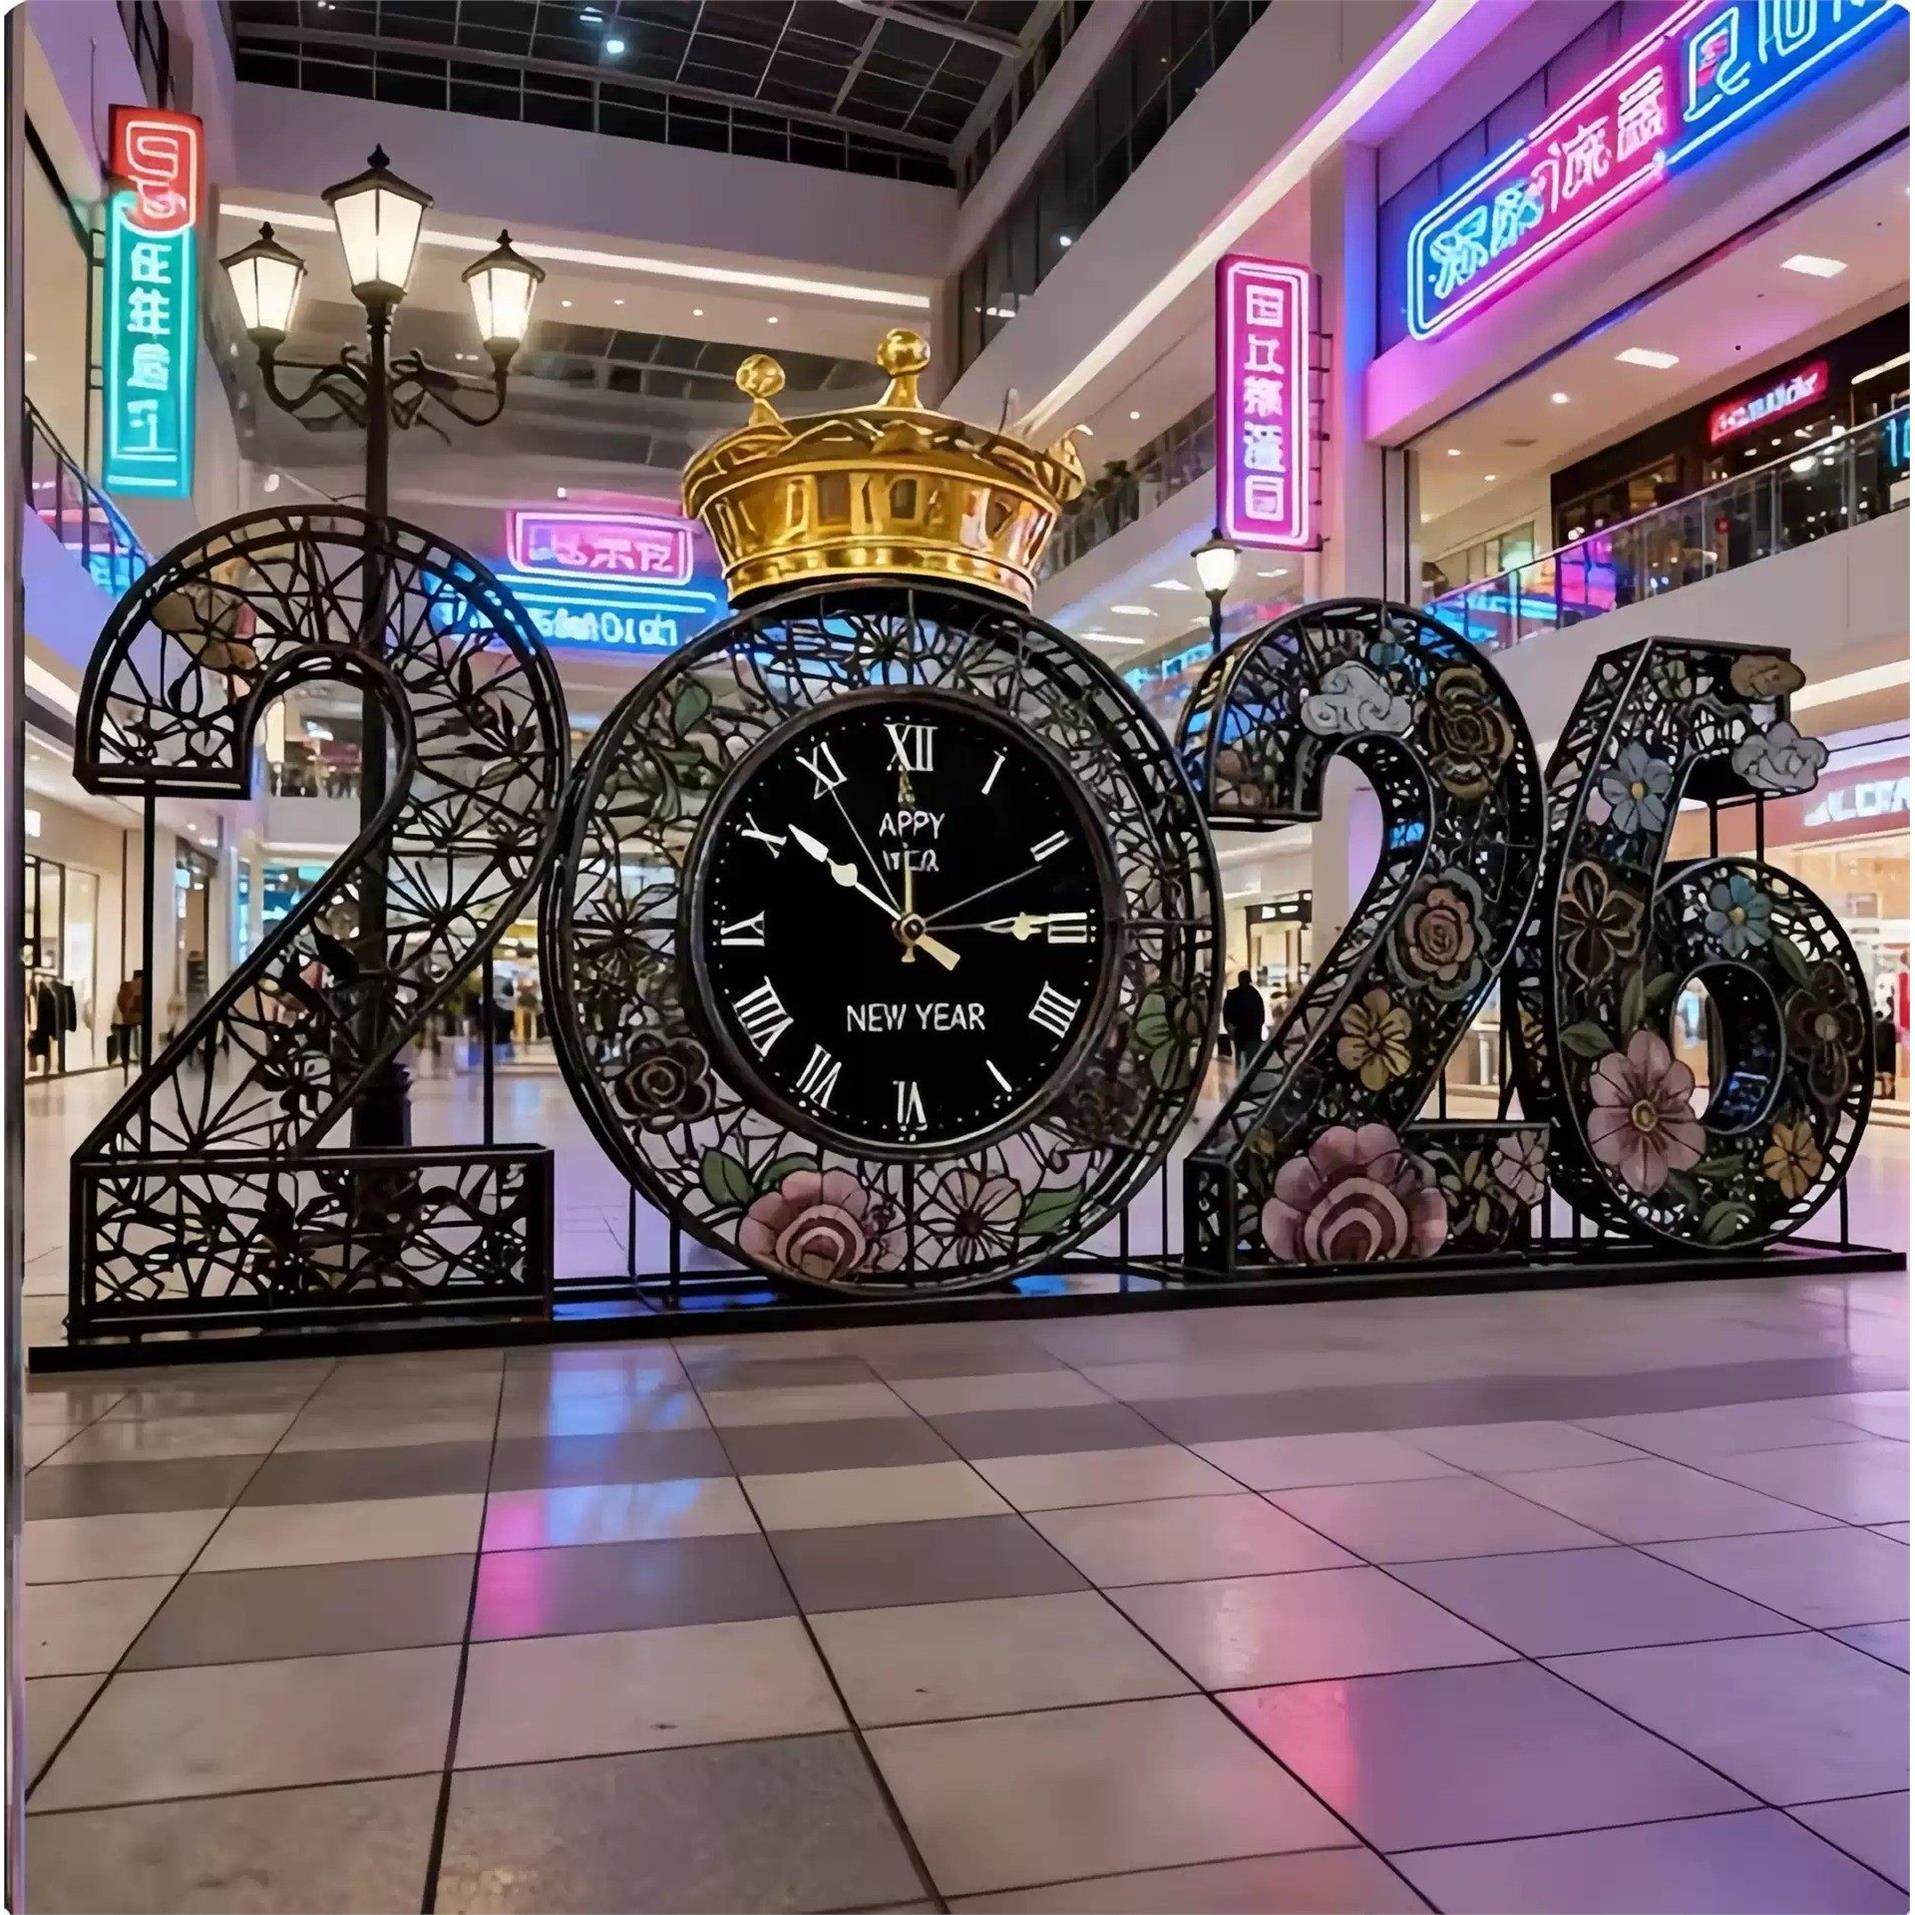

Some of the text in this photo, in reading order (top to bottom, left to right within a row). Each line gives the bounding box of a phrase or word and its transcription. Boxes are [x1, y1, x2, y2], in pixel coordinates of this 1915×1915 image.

[884, 723, 938, 771] XII
[878, 810, 945, 840] APPY
[846, 1003, 986, 1032] NEW YEAR
